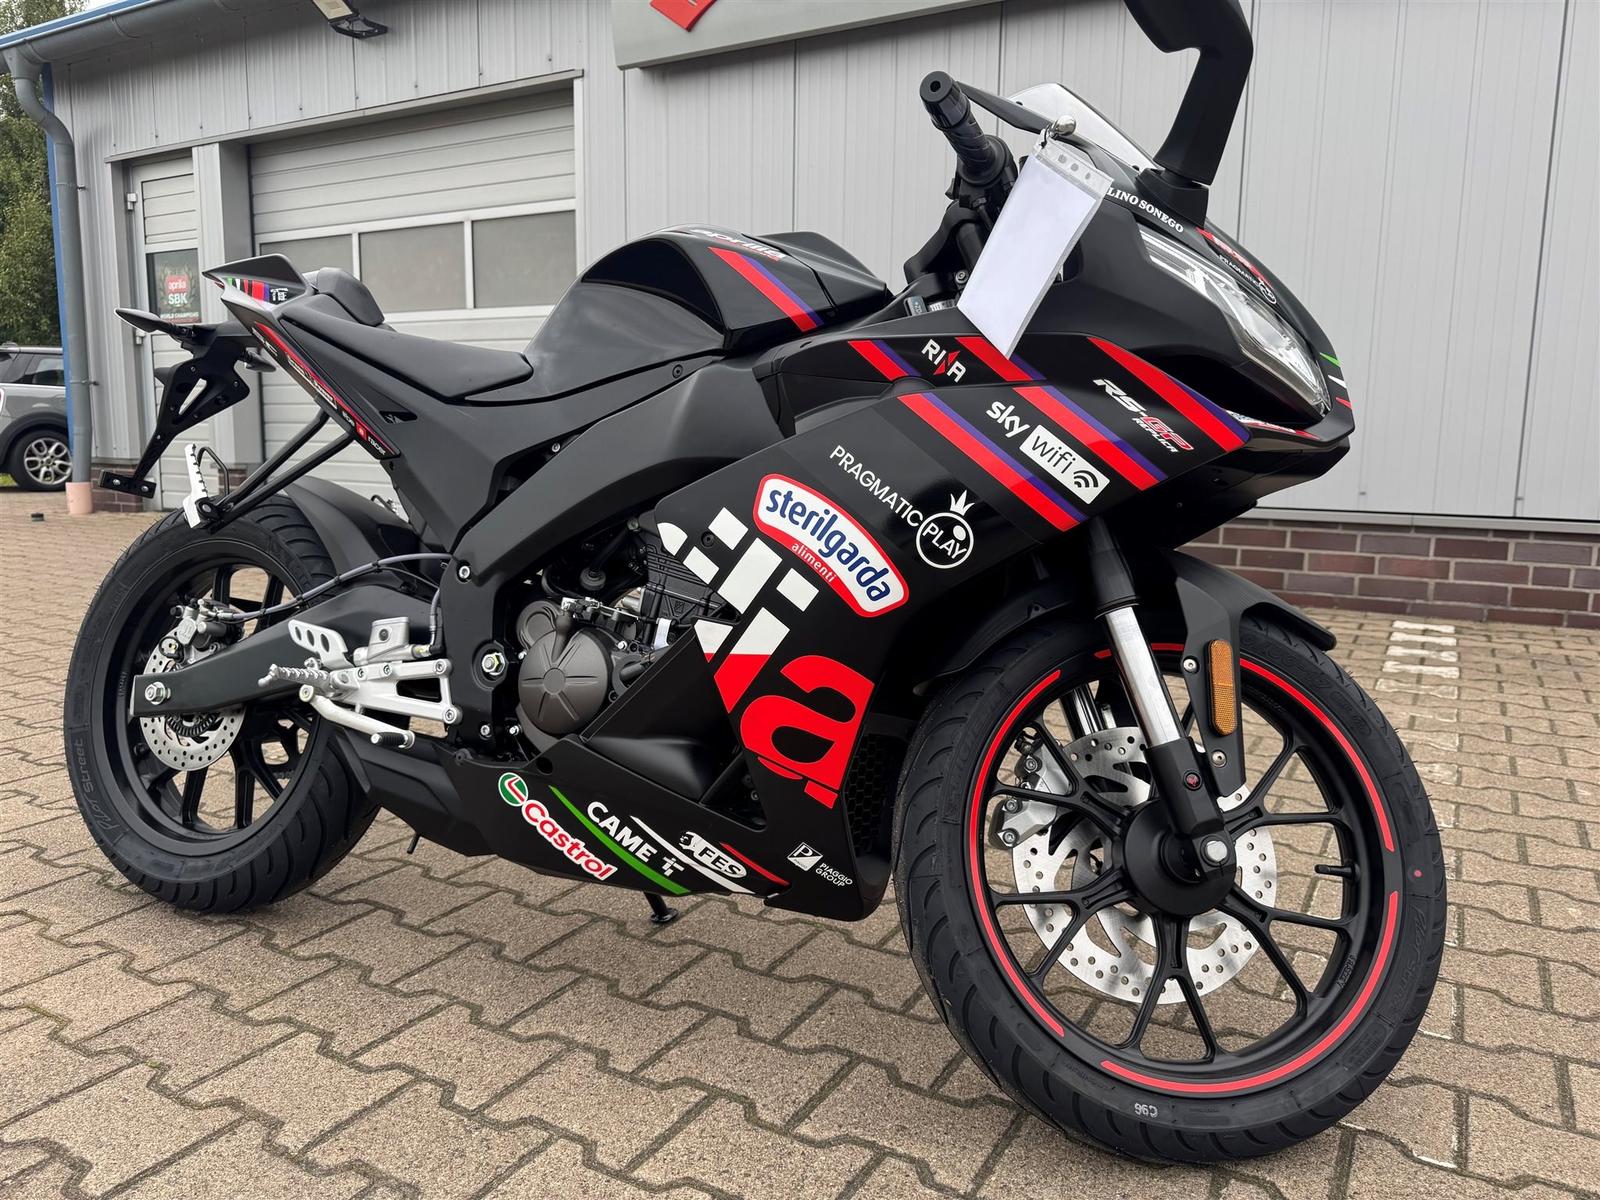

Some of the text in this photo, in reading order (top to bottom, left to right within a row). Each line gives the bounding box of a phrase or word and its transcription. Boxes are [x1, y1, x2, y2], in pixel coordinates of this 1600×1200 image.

[1106, 187, 1184, 233] LINO SONEGO
[168, 292, 188, 305] SBK
[985, 401, 1076, 475] sky wifi
[1131, 417, 1179, 453] REPLICA
[829, 445, 967, 562] PRAGMATIC PLAY
[765, 488, 891, 603] sterilgarda
[791, 541, 836, 583] alimenti
[522, 799, 618, 881] Castrol
[587, 801, 658, 863] CAME
[815, 868, 846, 887] GROUP
[819, 862, 853, 886] PIAGGIO
[1134, 1102, 1158, 1118] C96
